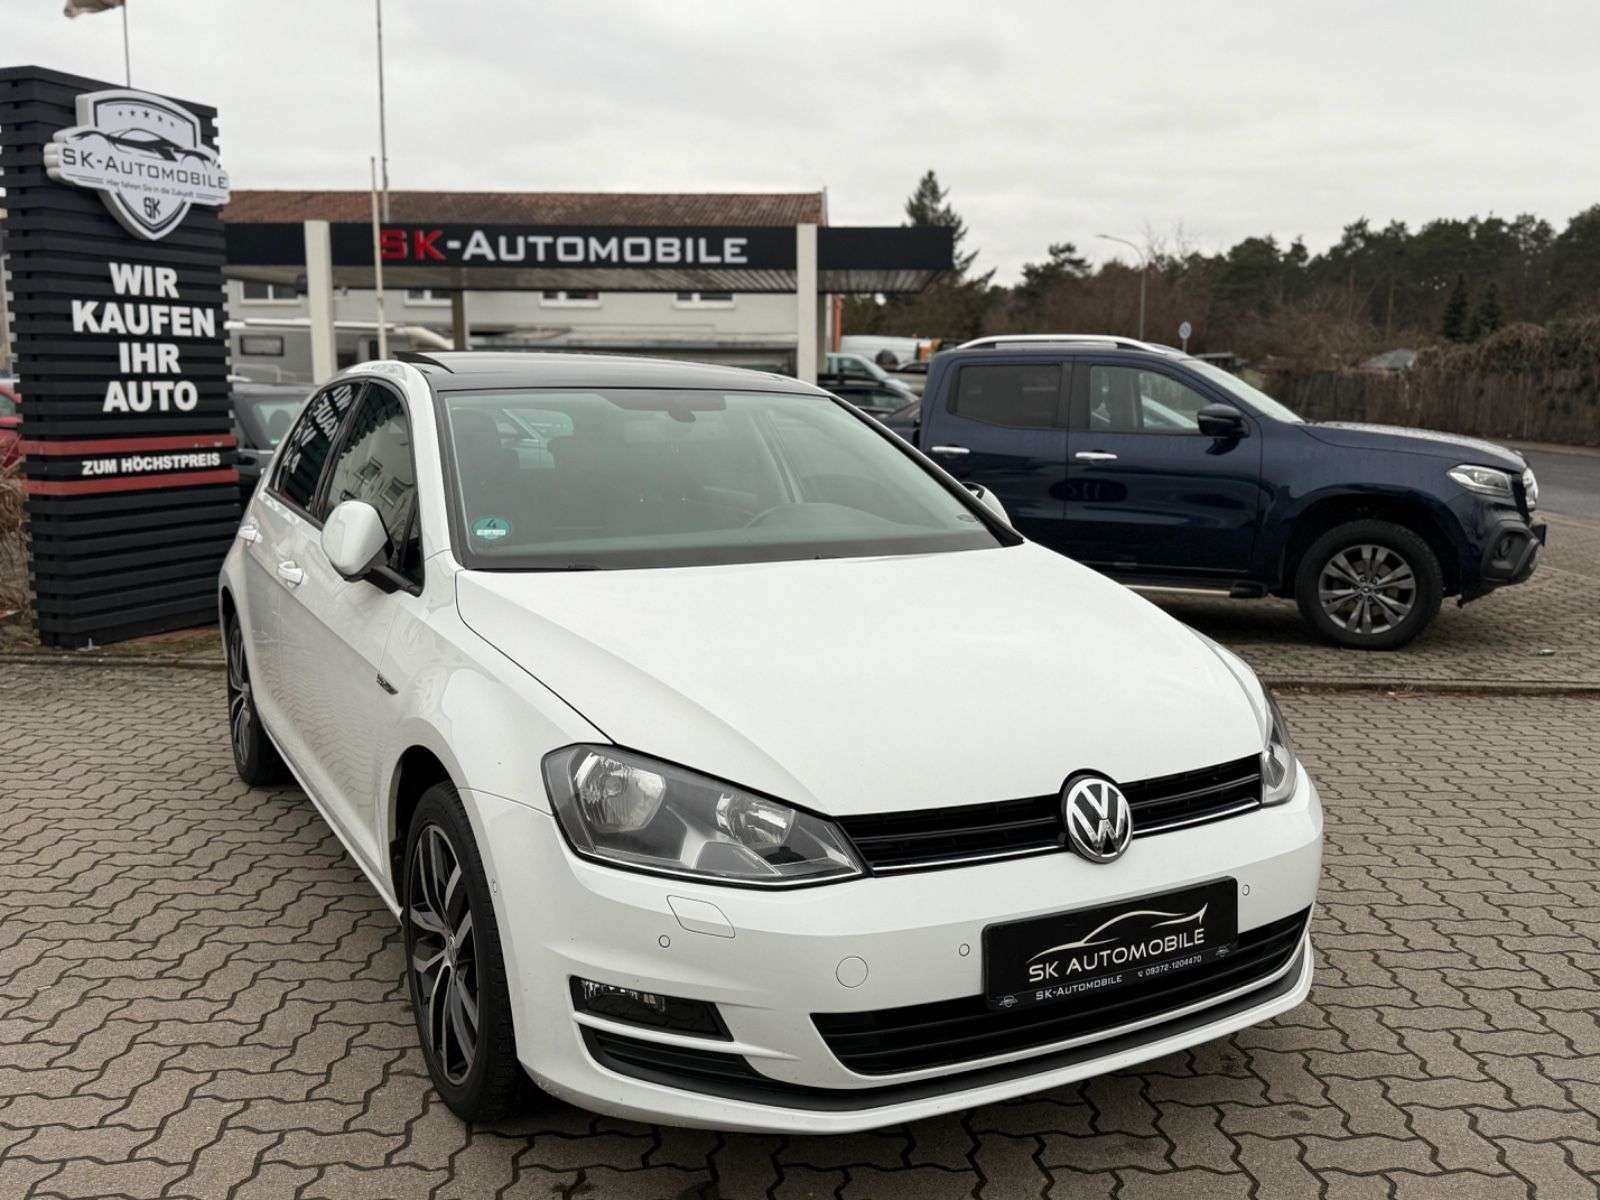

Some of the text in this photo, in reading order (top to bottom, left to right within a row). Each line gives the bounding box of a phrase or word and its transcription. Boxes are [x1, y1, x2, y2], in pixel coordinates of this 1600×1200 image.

[108, 262, 180, 298] WIR
[71, 299, 216, 337] KAUFEN
[118, 342, 182, 374] IHR
[102, 380, 199, 413] AUTO
[81, 451, 221, 476] ZUM HÖCHSTPREIS
[1028, 928, 1206, 983] SK AUTOMOBILE
